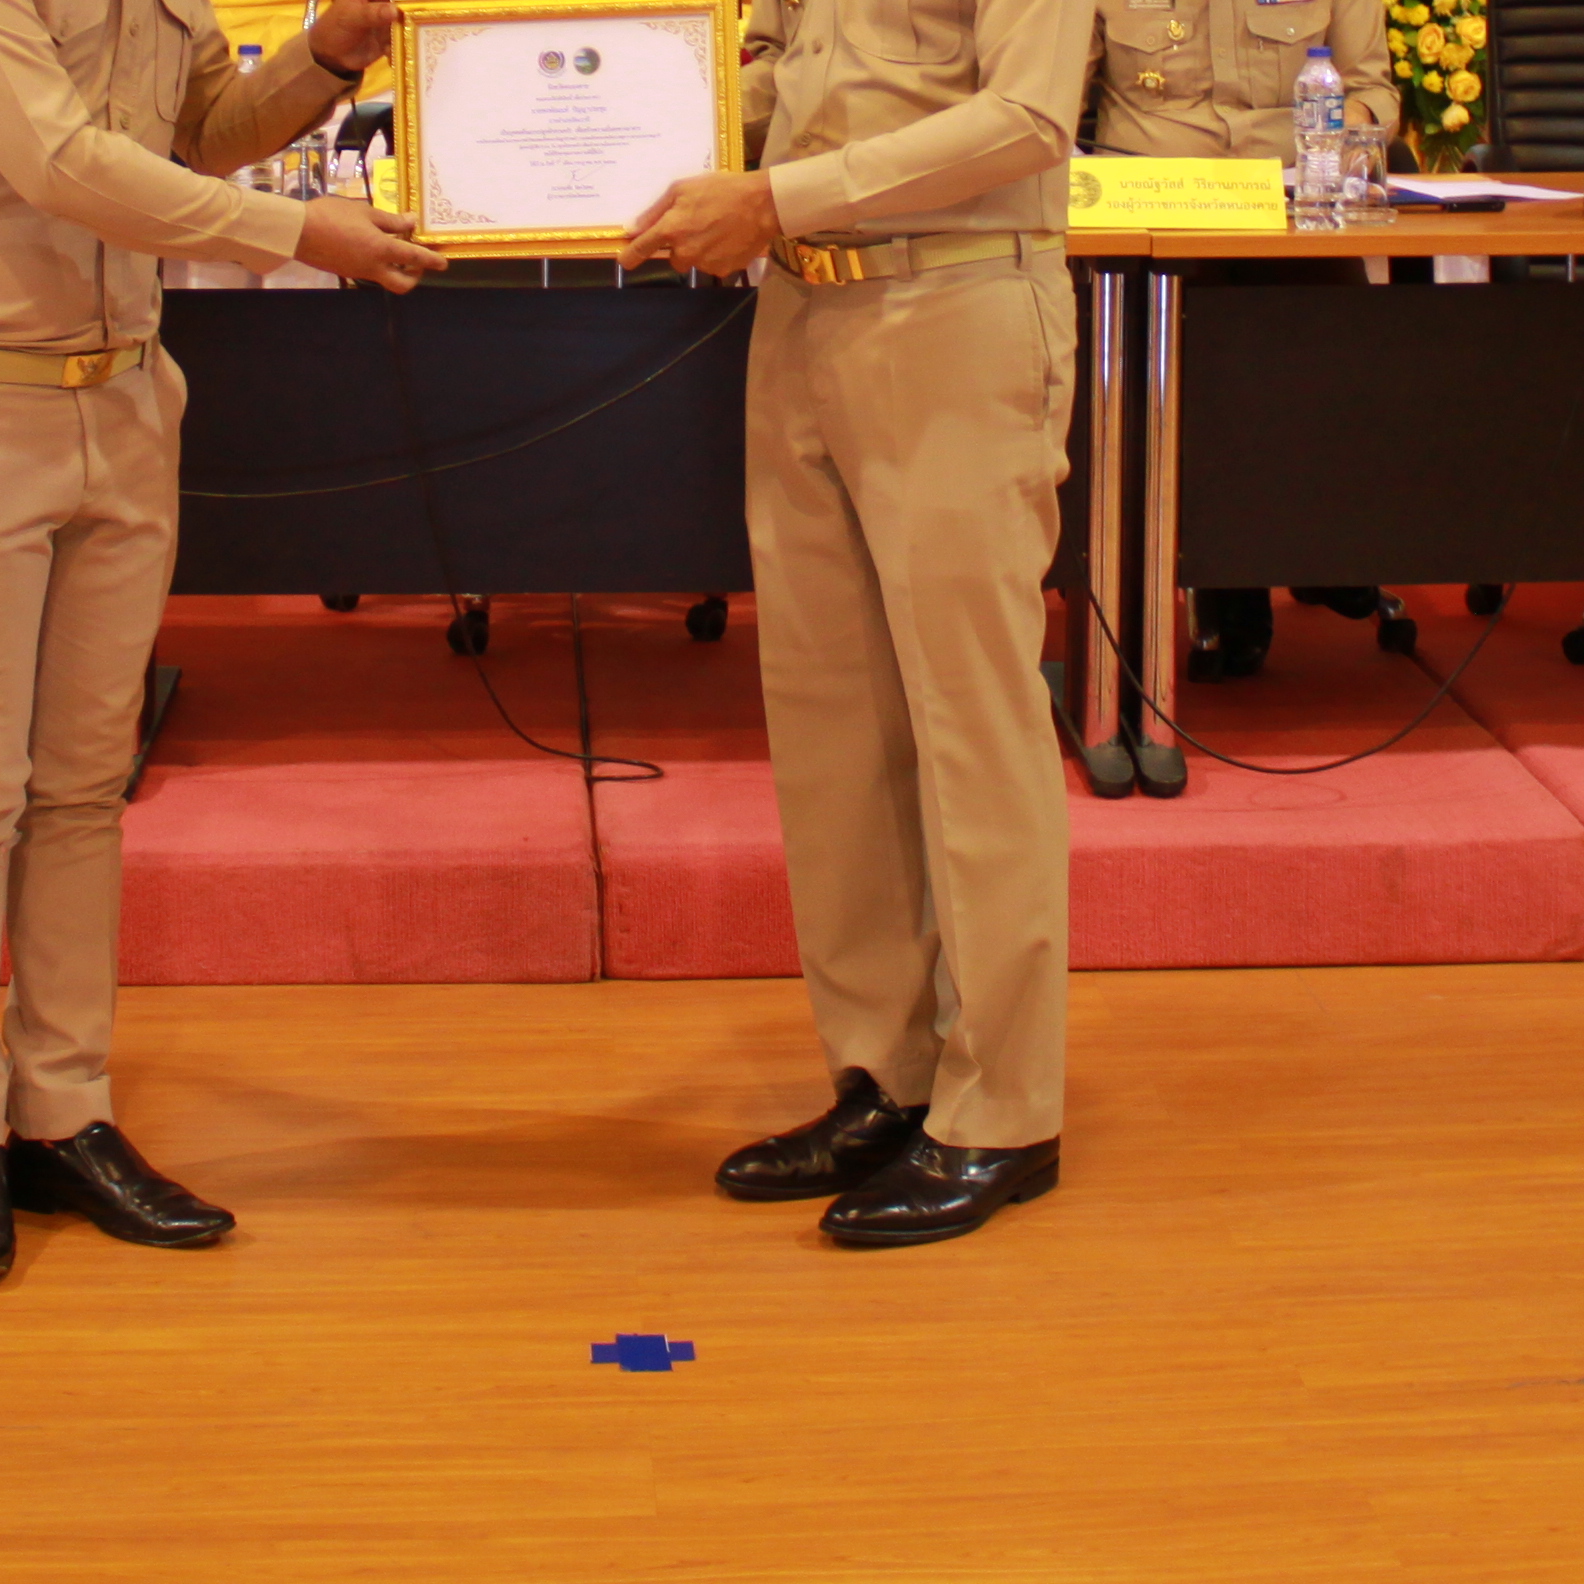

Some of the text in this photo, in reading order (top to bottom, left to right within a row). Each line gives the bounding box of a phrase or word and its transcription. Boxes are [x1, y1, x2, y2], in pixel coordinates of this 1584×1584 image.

[1106, 197, 1278, 214] รองผู้ว่าราชการจังหวัดหนองคาย
